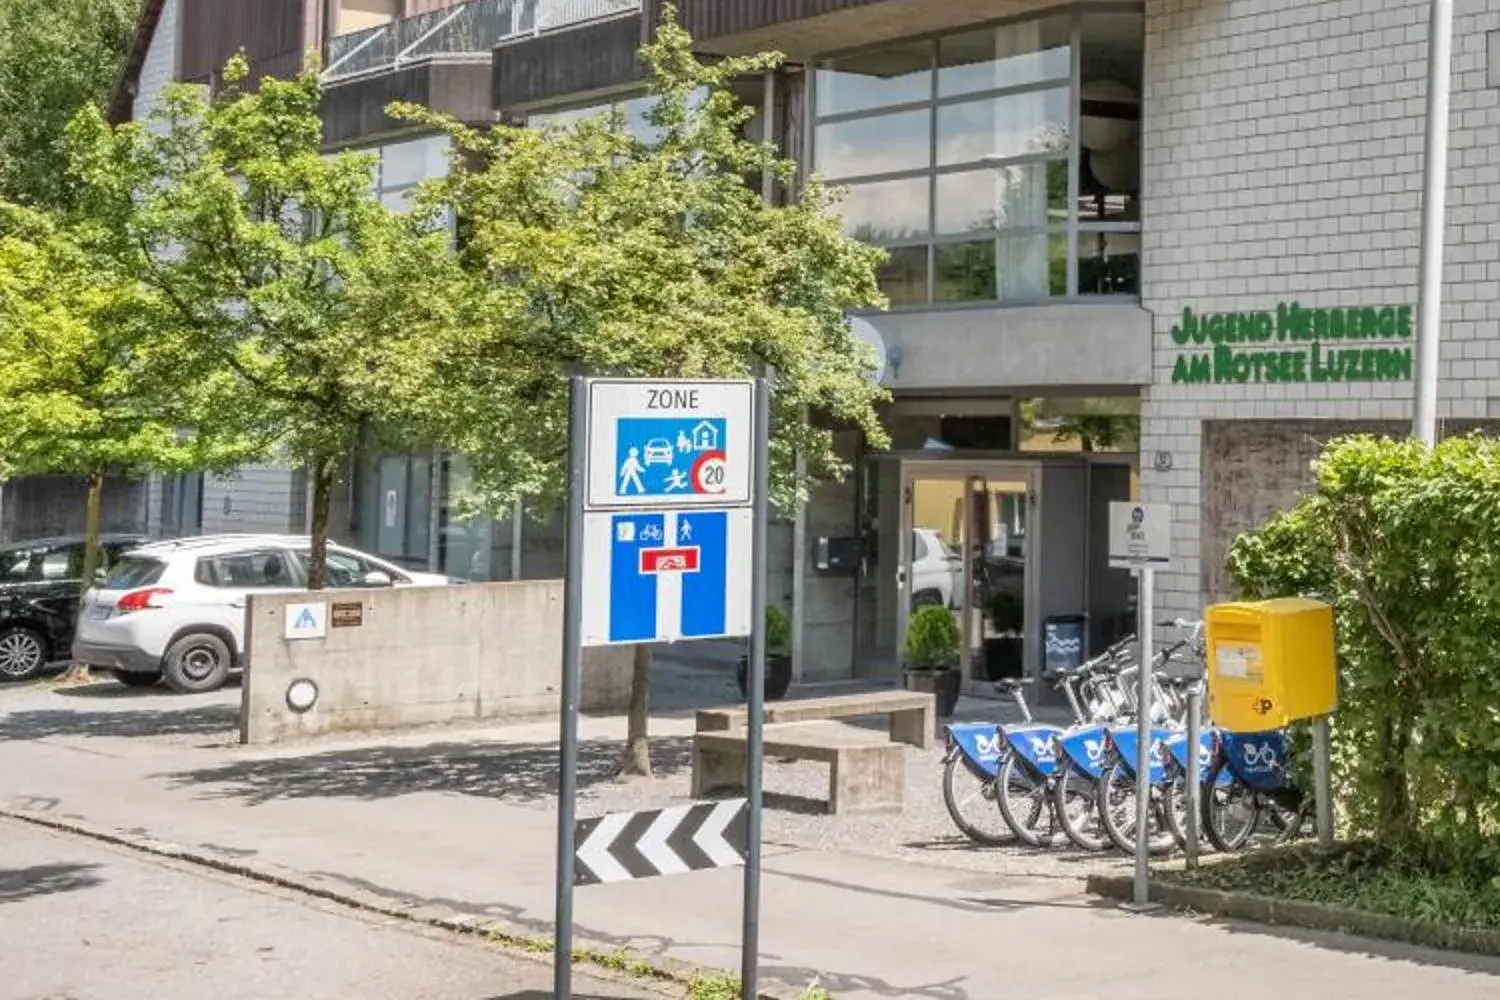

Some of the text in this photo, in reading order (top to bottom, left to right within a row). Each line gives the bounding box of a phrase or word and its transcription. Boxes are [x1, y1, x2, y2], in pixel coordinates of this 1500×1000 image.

[1311, 341, 1411, 382] LUZERN
[647, 389, 699, 410] ZONE
[705, 465, 724, 485] 20
